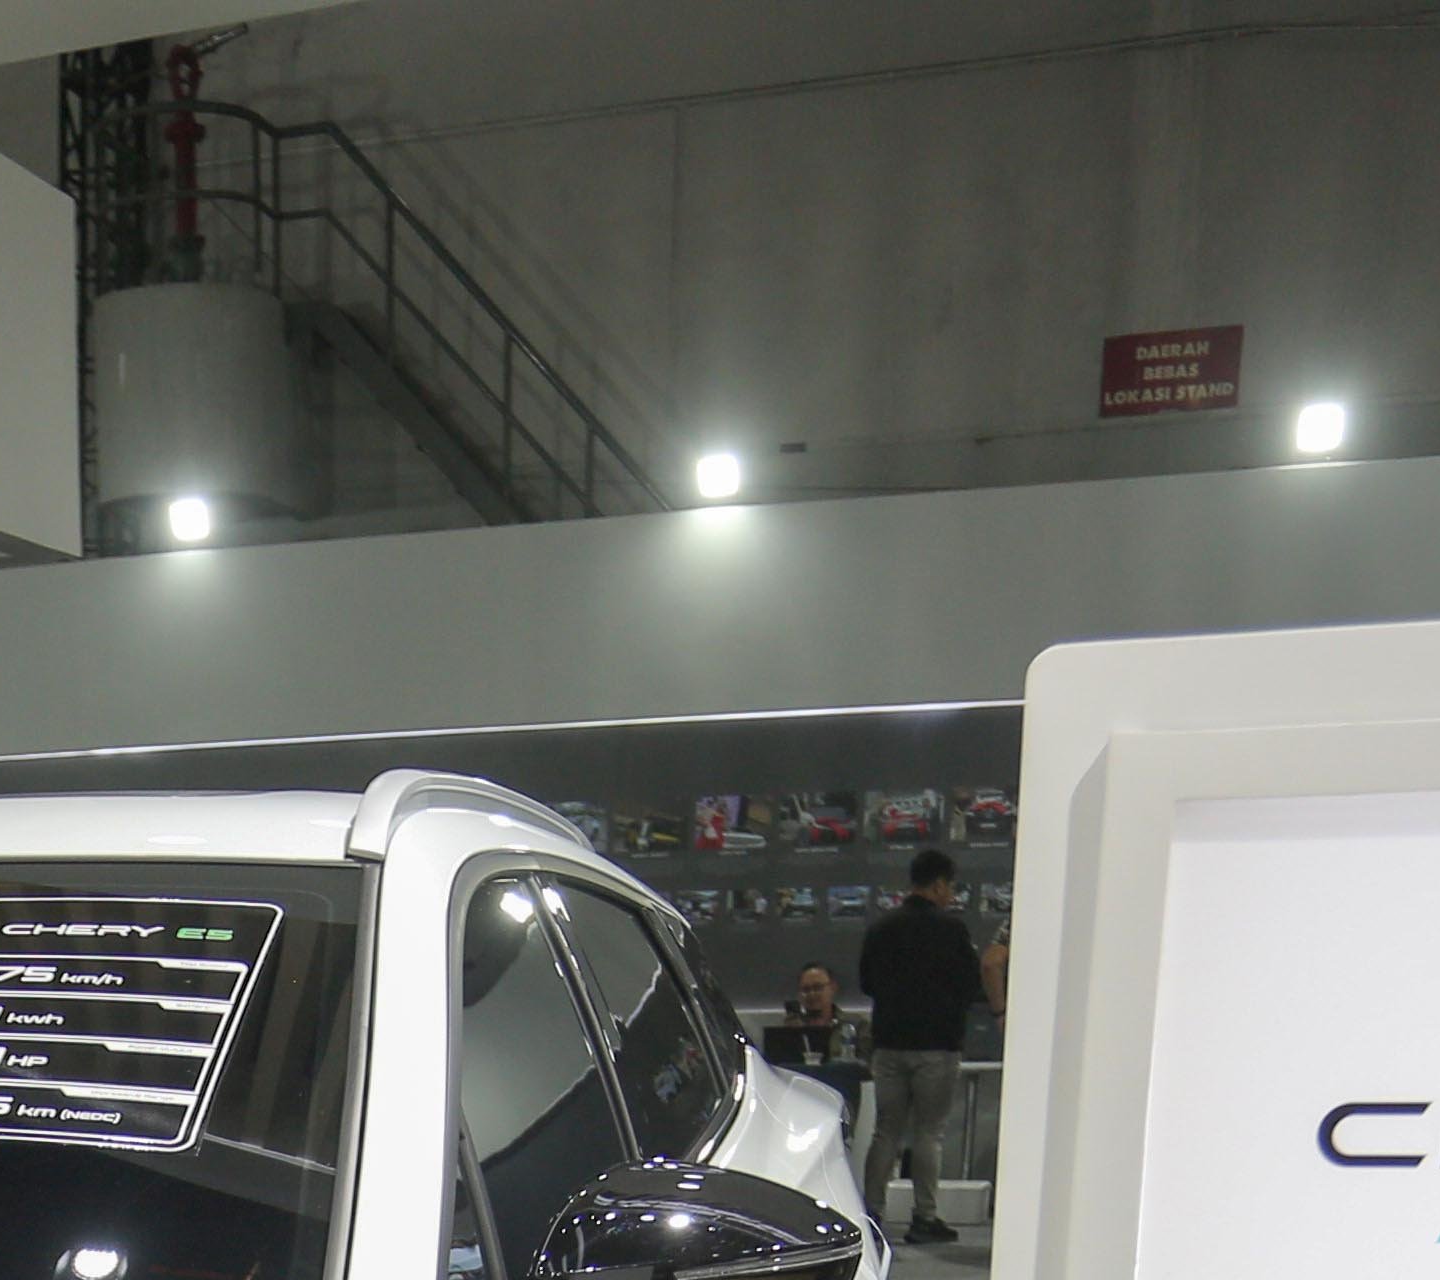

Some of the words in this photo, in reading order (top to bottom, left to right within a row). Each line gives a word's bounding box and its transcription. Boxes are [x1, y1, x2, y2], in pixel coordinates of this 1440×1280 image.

[1104, 385, 1172, 405] LOKASI
[1175, 382, 1235, 400] STAND
[1, 923, 165, 939] CHERY
[176, 926, 235, 941] E5
[59, 970, 124, 988] km/h
[6, 1053, 50, 1068] HP
[17, 1102, 57, 1119] km
